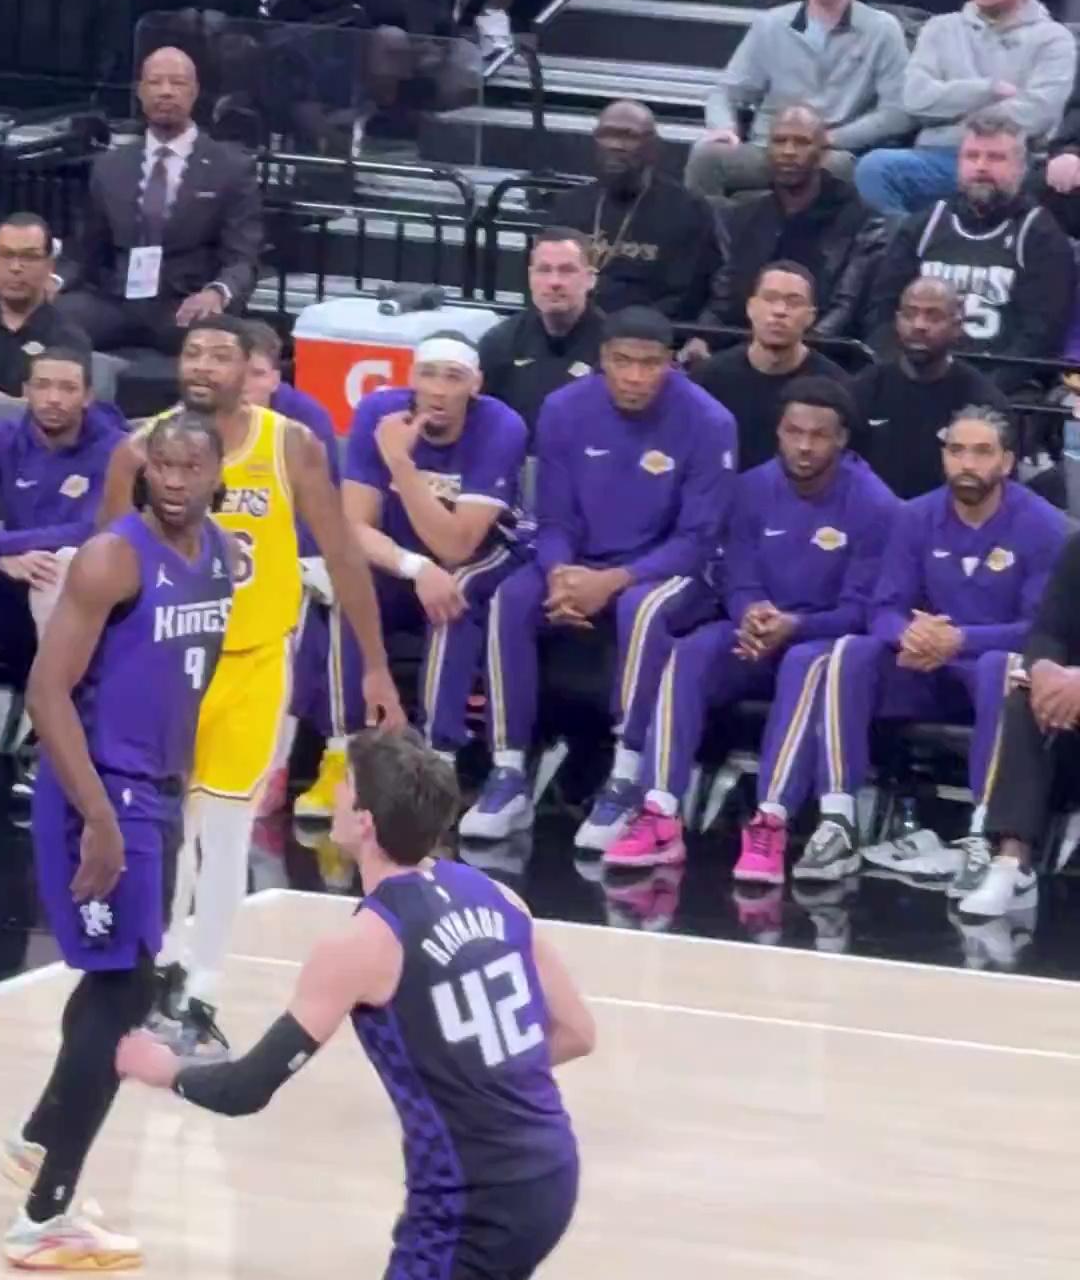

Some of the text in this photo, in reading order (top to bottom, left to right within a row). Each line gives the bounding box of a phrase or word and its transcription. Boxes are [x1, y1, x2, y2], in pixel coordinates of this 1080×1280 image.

[345, 359, 393, 410] G
[221, 488, 270, 517] ERS
[231, 530, 255, 588] 6
[184, 646, 206, 690] 9
[431, 951, 545, 1067] 42
